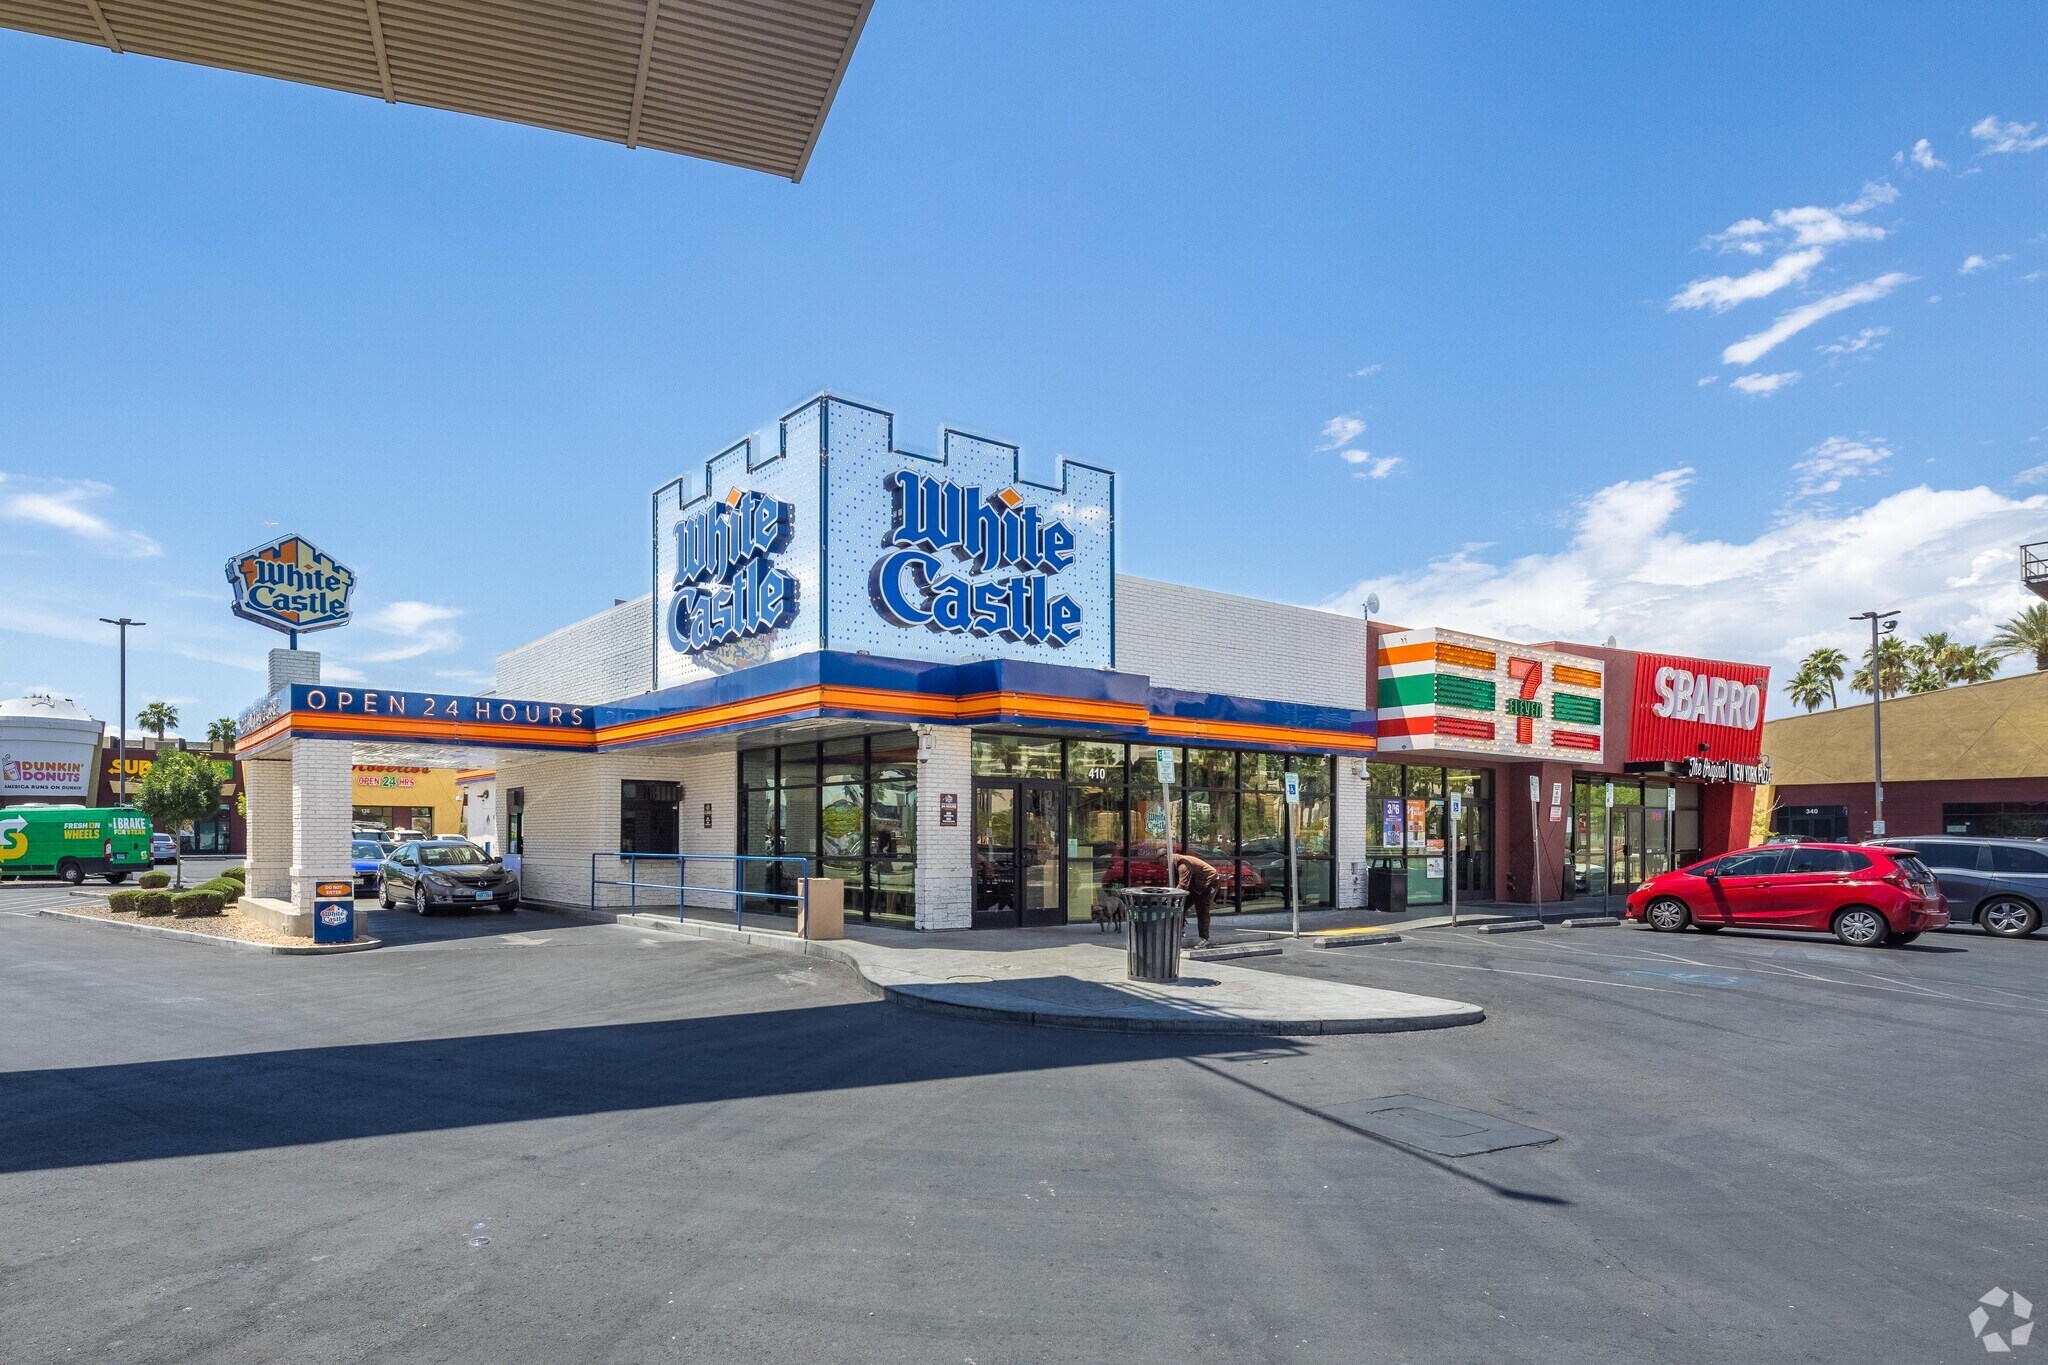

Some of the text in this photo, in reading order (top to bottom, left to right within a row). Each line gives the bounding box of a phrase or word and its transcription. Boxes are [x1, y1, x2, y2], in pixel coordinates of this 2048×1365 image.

[885, 468, 1076, 575] White
[671, 486, 794, 591] White
[254, 560, 341, 592] White
[248, 585, 345, 616] Castle
[667, 557, 797, 654] Castle
[872, 549, 1083, 647] Castle
[307, 689, 583, 726] OPEN 24 HOURS
[1508, 656, 1542, 744] 7
[1652, 666, 1760, 731] SBARRO
[22, 761, 84, 773] DUNKIN'
[22, 771, 80, 782] DONUTS
[1088, 768, 1106, 779] 410
[1689, 757, 1702, 777] The
[1703, 758, 1728, 783] Original
[1732, 763, 1744, 781] NEW
[1745, 764, 1757, 782] YORK
[358, 776, 415, 787] OPEN 24 HRS
[117, 818, 146, 829] BRAKE
[1146, 821, 1166, 830] Castl
[1148, 812, 1166, 821] Whit
[64, 830, 100, 839] WHEELS
